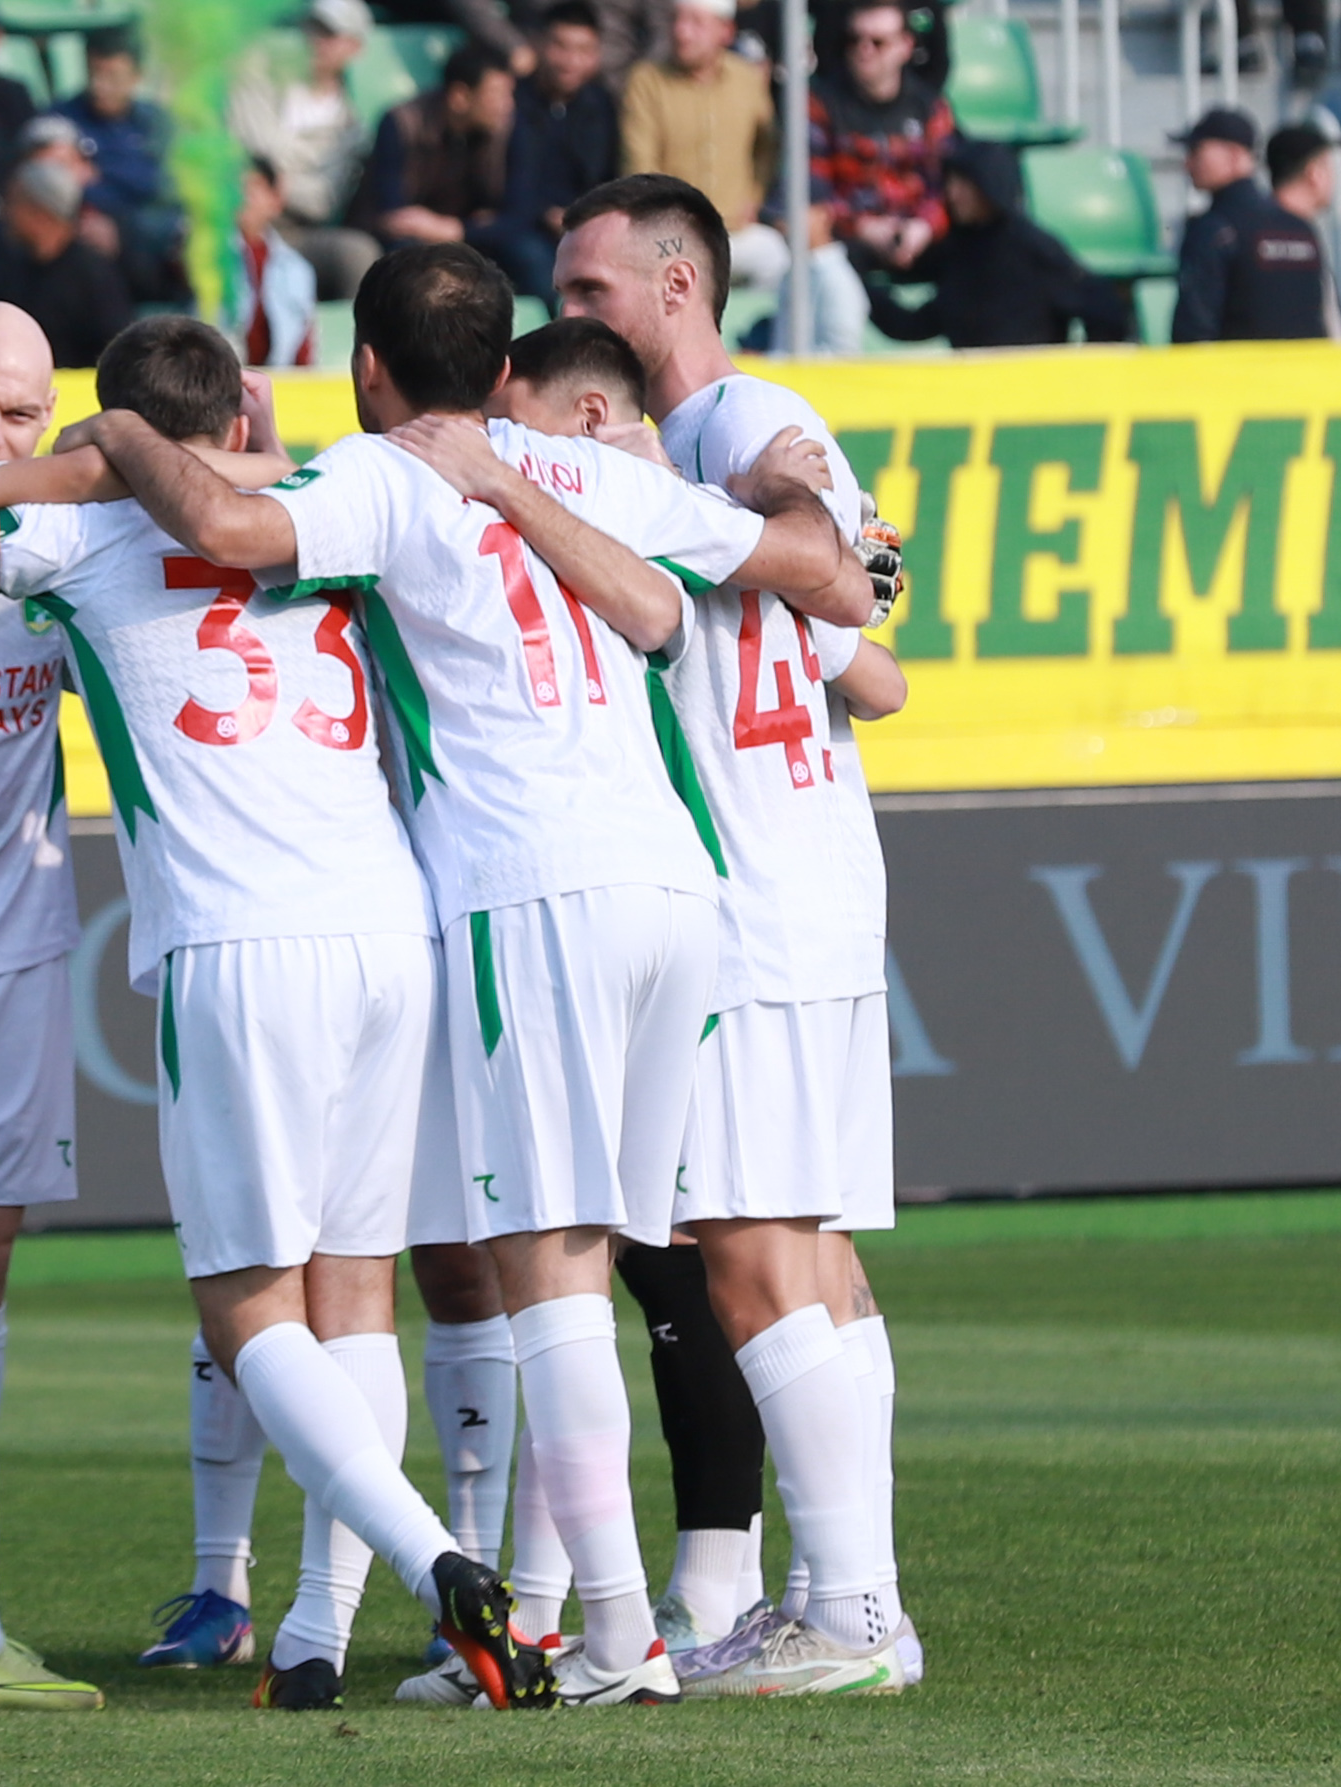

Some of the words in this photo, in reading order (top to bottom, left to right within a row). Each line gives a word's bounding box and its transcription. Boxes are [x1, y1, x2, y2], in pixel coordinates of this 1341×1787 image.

[655, 237, 682, 258] XV
[163, 556, 369, 751] 33
[733, 589, 834, 789] 4
[1027, 855, 1341, 1073] VI
